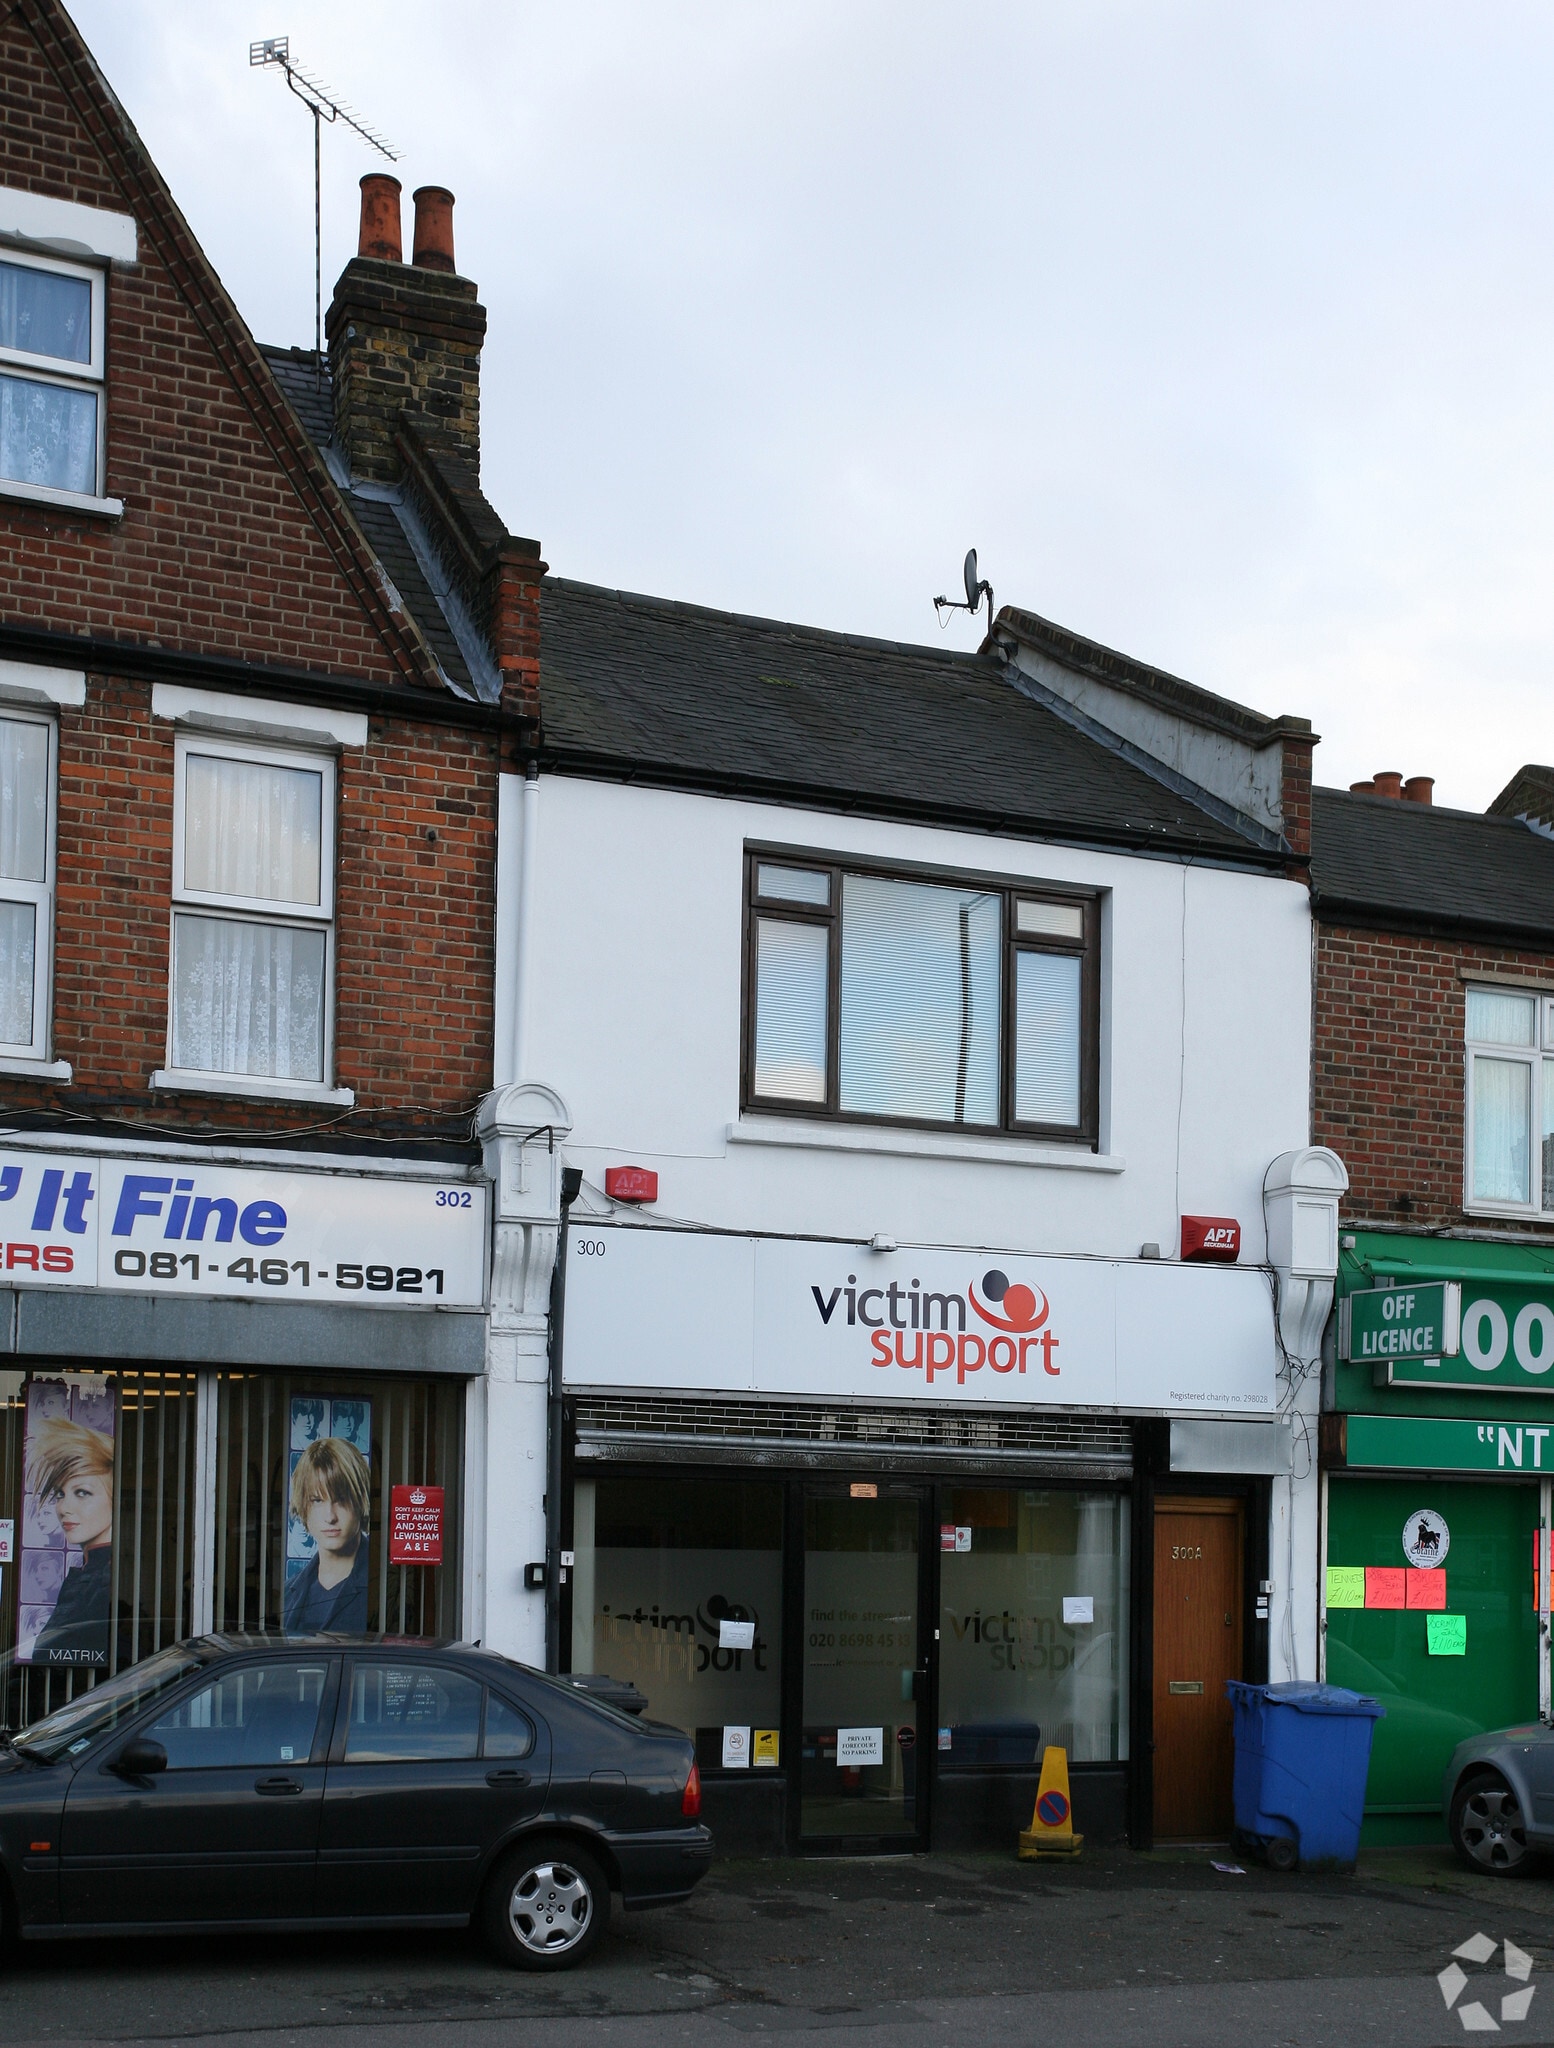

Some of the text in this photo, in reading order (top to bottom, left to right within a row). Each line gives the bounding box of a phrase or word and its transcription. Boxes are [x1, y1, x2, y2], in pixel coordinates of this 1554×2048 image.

[435, 1190, 472, 1208] 302
[31, 1169, 95, 1234] It
[112, 1174, 287, 1246] Fine
[1204, 1228, 1236, 1243] APT
[577, 1240, 606, 1256] 300
[0, 1242, 74, 1273] RS
[114, 1250, 444, 1294] 081-461-5921
[811, 1274, 966, 1331] victim
[1382, 1295, 1415, 1321] OFF
[1362, 1326, 1434, 1355] LICENCE
[871, 1328, 1060, 1384] support
[1170, 1391, 1205, 1402] Registered
[1206, 1393, 1229, 1403] charity
[1243, 1394, 1268, 1403] 298028
[395, 1513, 410, 1521] GET
[417, 1523, 439, 1531] SAVE
[394, 1532, 439, 1540] LEWISHAM
[404, 1543, 429, 1551] A & E
[1171, 1546, 1202, 1560] 300A
[810, 1609, 834, 1621] find
[809, 1633, 835, 1648] 020
[839, 1633, 873, 1648] 8698
[49, 1649, 105, 1661] MATRIX
